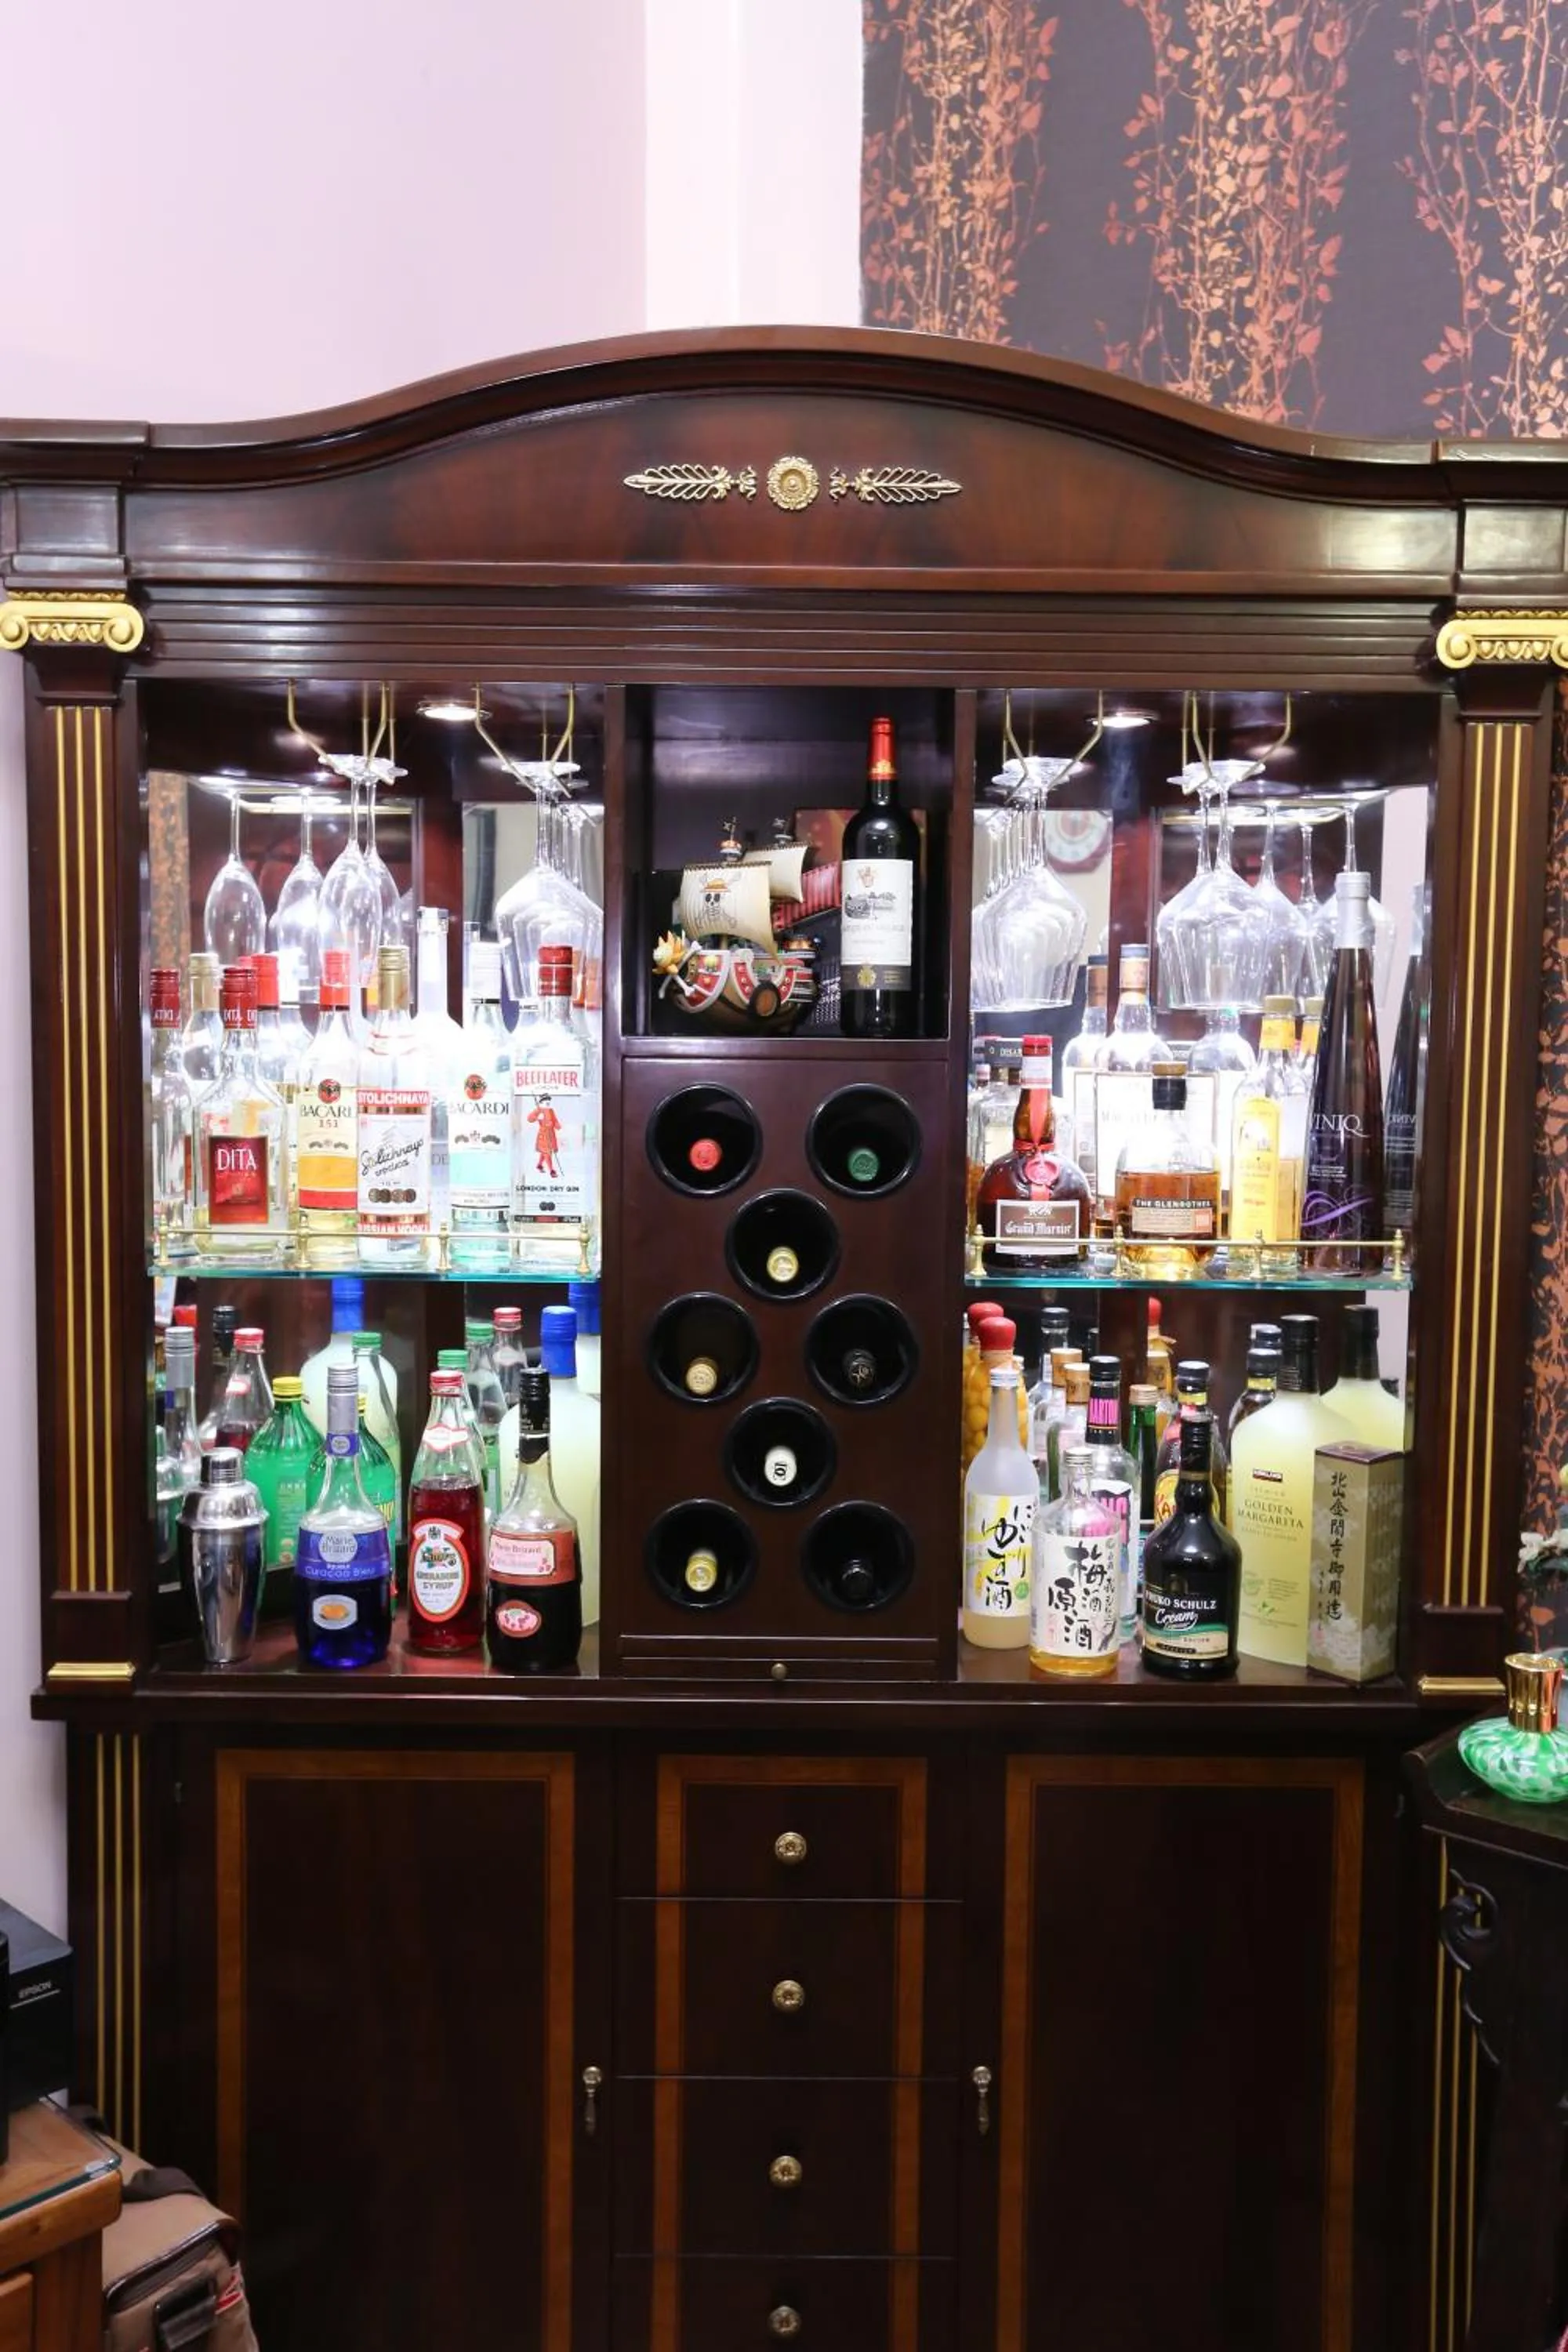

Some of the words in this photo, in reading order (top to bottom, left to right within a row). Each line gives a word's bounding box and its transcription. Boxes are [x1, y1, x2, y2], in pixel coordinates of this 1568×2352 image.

[516, 1071, 579, 1087] BEEFEATER
[318, 1120, 339, 1128] 151
[217, 1149, 257, 1171] DITA
[1135, 1199, 1151, 1207] THE
[1243, 1498, 1293, 1515] GOLDEN
[1237, 1508, 1304, 1530] MARGARITA
[326, 1535, 354, 1545] Marie
[423, 1581, 454, 1590] SYRUP
[1174, 1599, 1218, 1610] SCHULZ
[1155, 1608, 1198, 1624] Cream
[19, 1980, 52, 1999] EPSON
